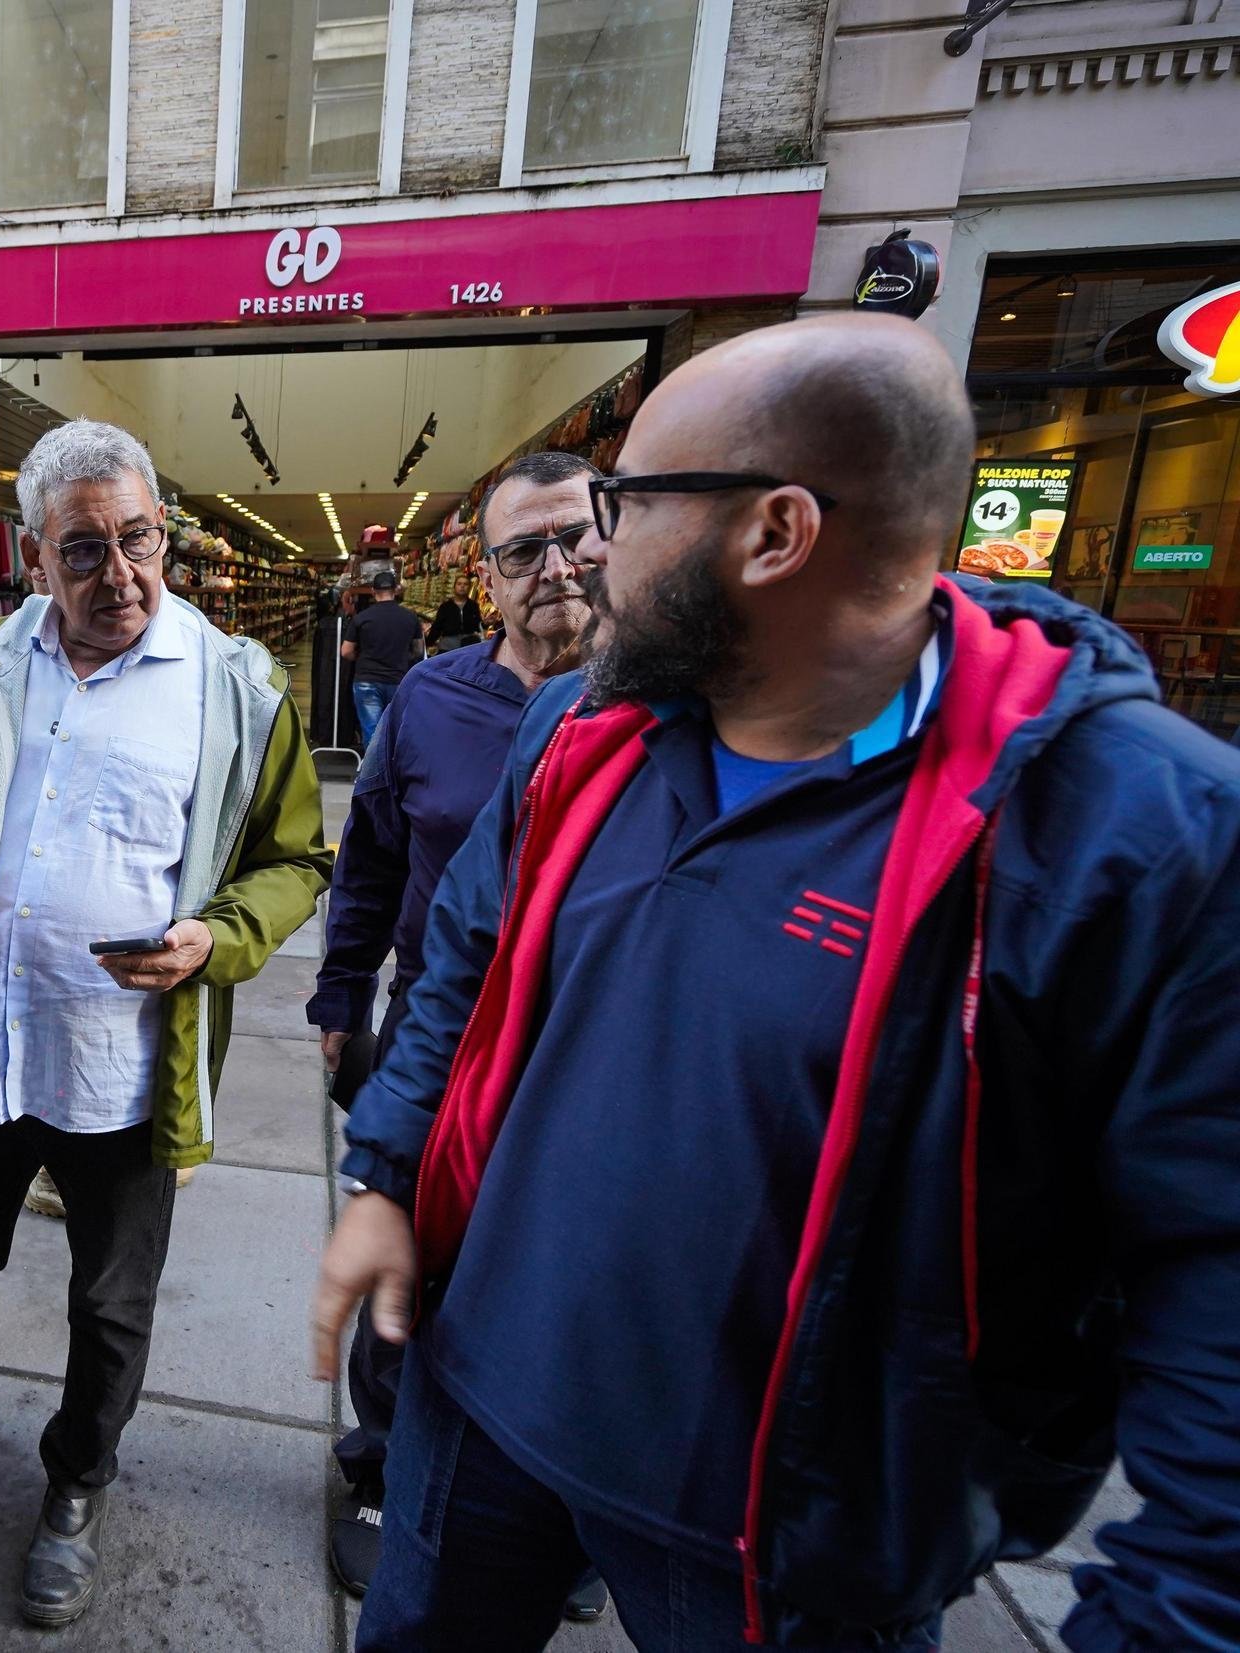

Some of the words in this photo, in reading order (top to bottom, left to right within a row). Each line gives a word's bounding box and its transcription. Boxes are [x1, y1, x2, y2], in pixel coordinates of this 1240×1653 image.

[266, 226, 342, 287] GD
[450, 282, 503, 304] 1426
[239, 293, 364, 315] PRESENTES
[978, 468, 1040, 479] KALZONE
[1041, 469, 1071, 479] POP
[987, 479, 1017, 488] SUCO
[1019, 480, 1068, 488] NATURAL
[1143, 552, 1204, 563] ABERTO
